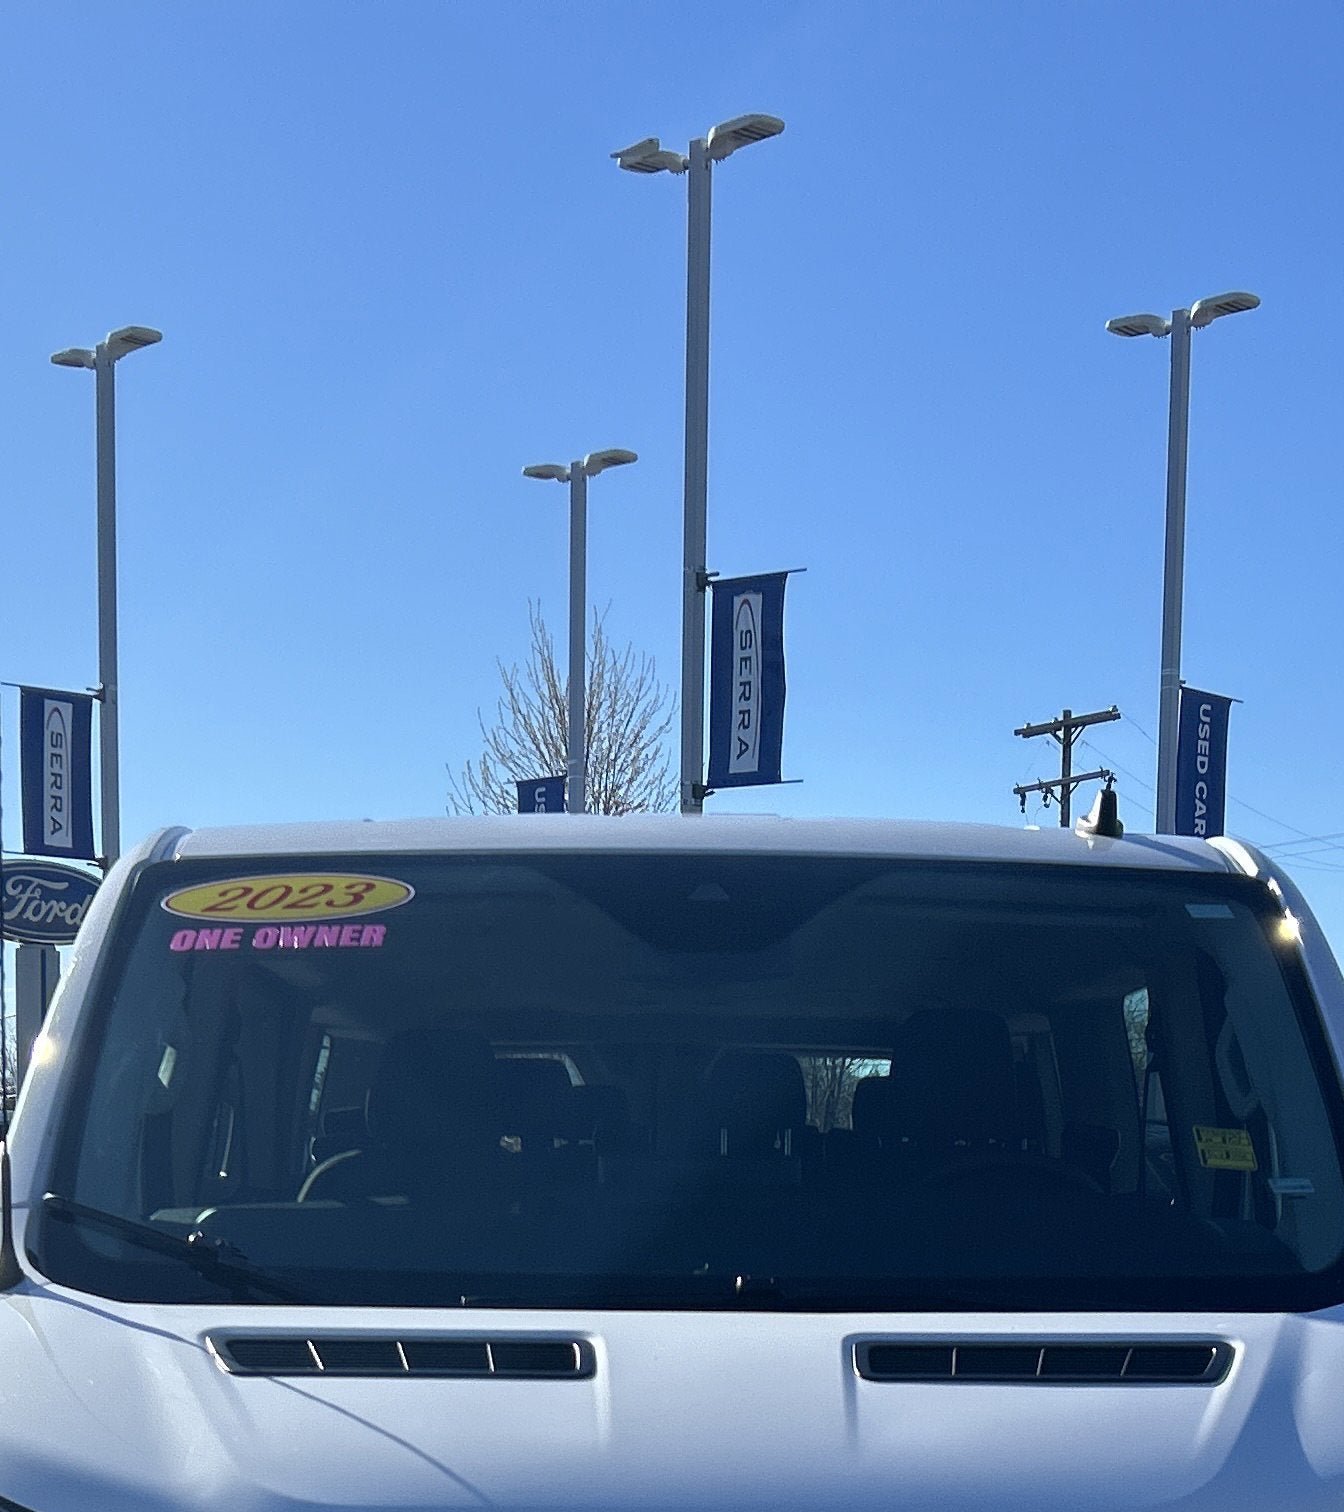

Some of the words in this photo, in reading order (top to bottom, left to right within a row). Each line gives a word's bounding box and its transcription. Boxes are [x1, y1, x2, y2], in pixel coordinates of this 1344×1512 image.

[736, 629, 753, 761] SERRA
[1196, 703, 1212, 775] USED
[50, 730, 63, 836] SERRA
[201, 882, 377, 913] 2023
[169, 928, 244, 951] ONE
[252, 924, 387, 949] OWNER
